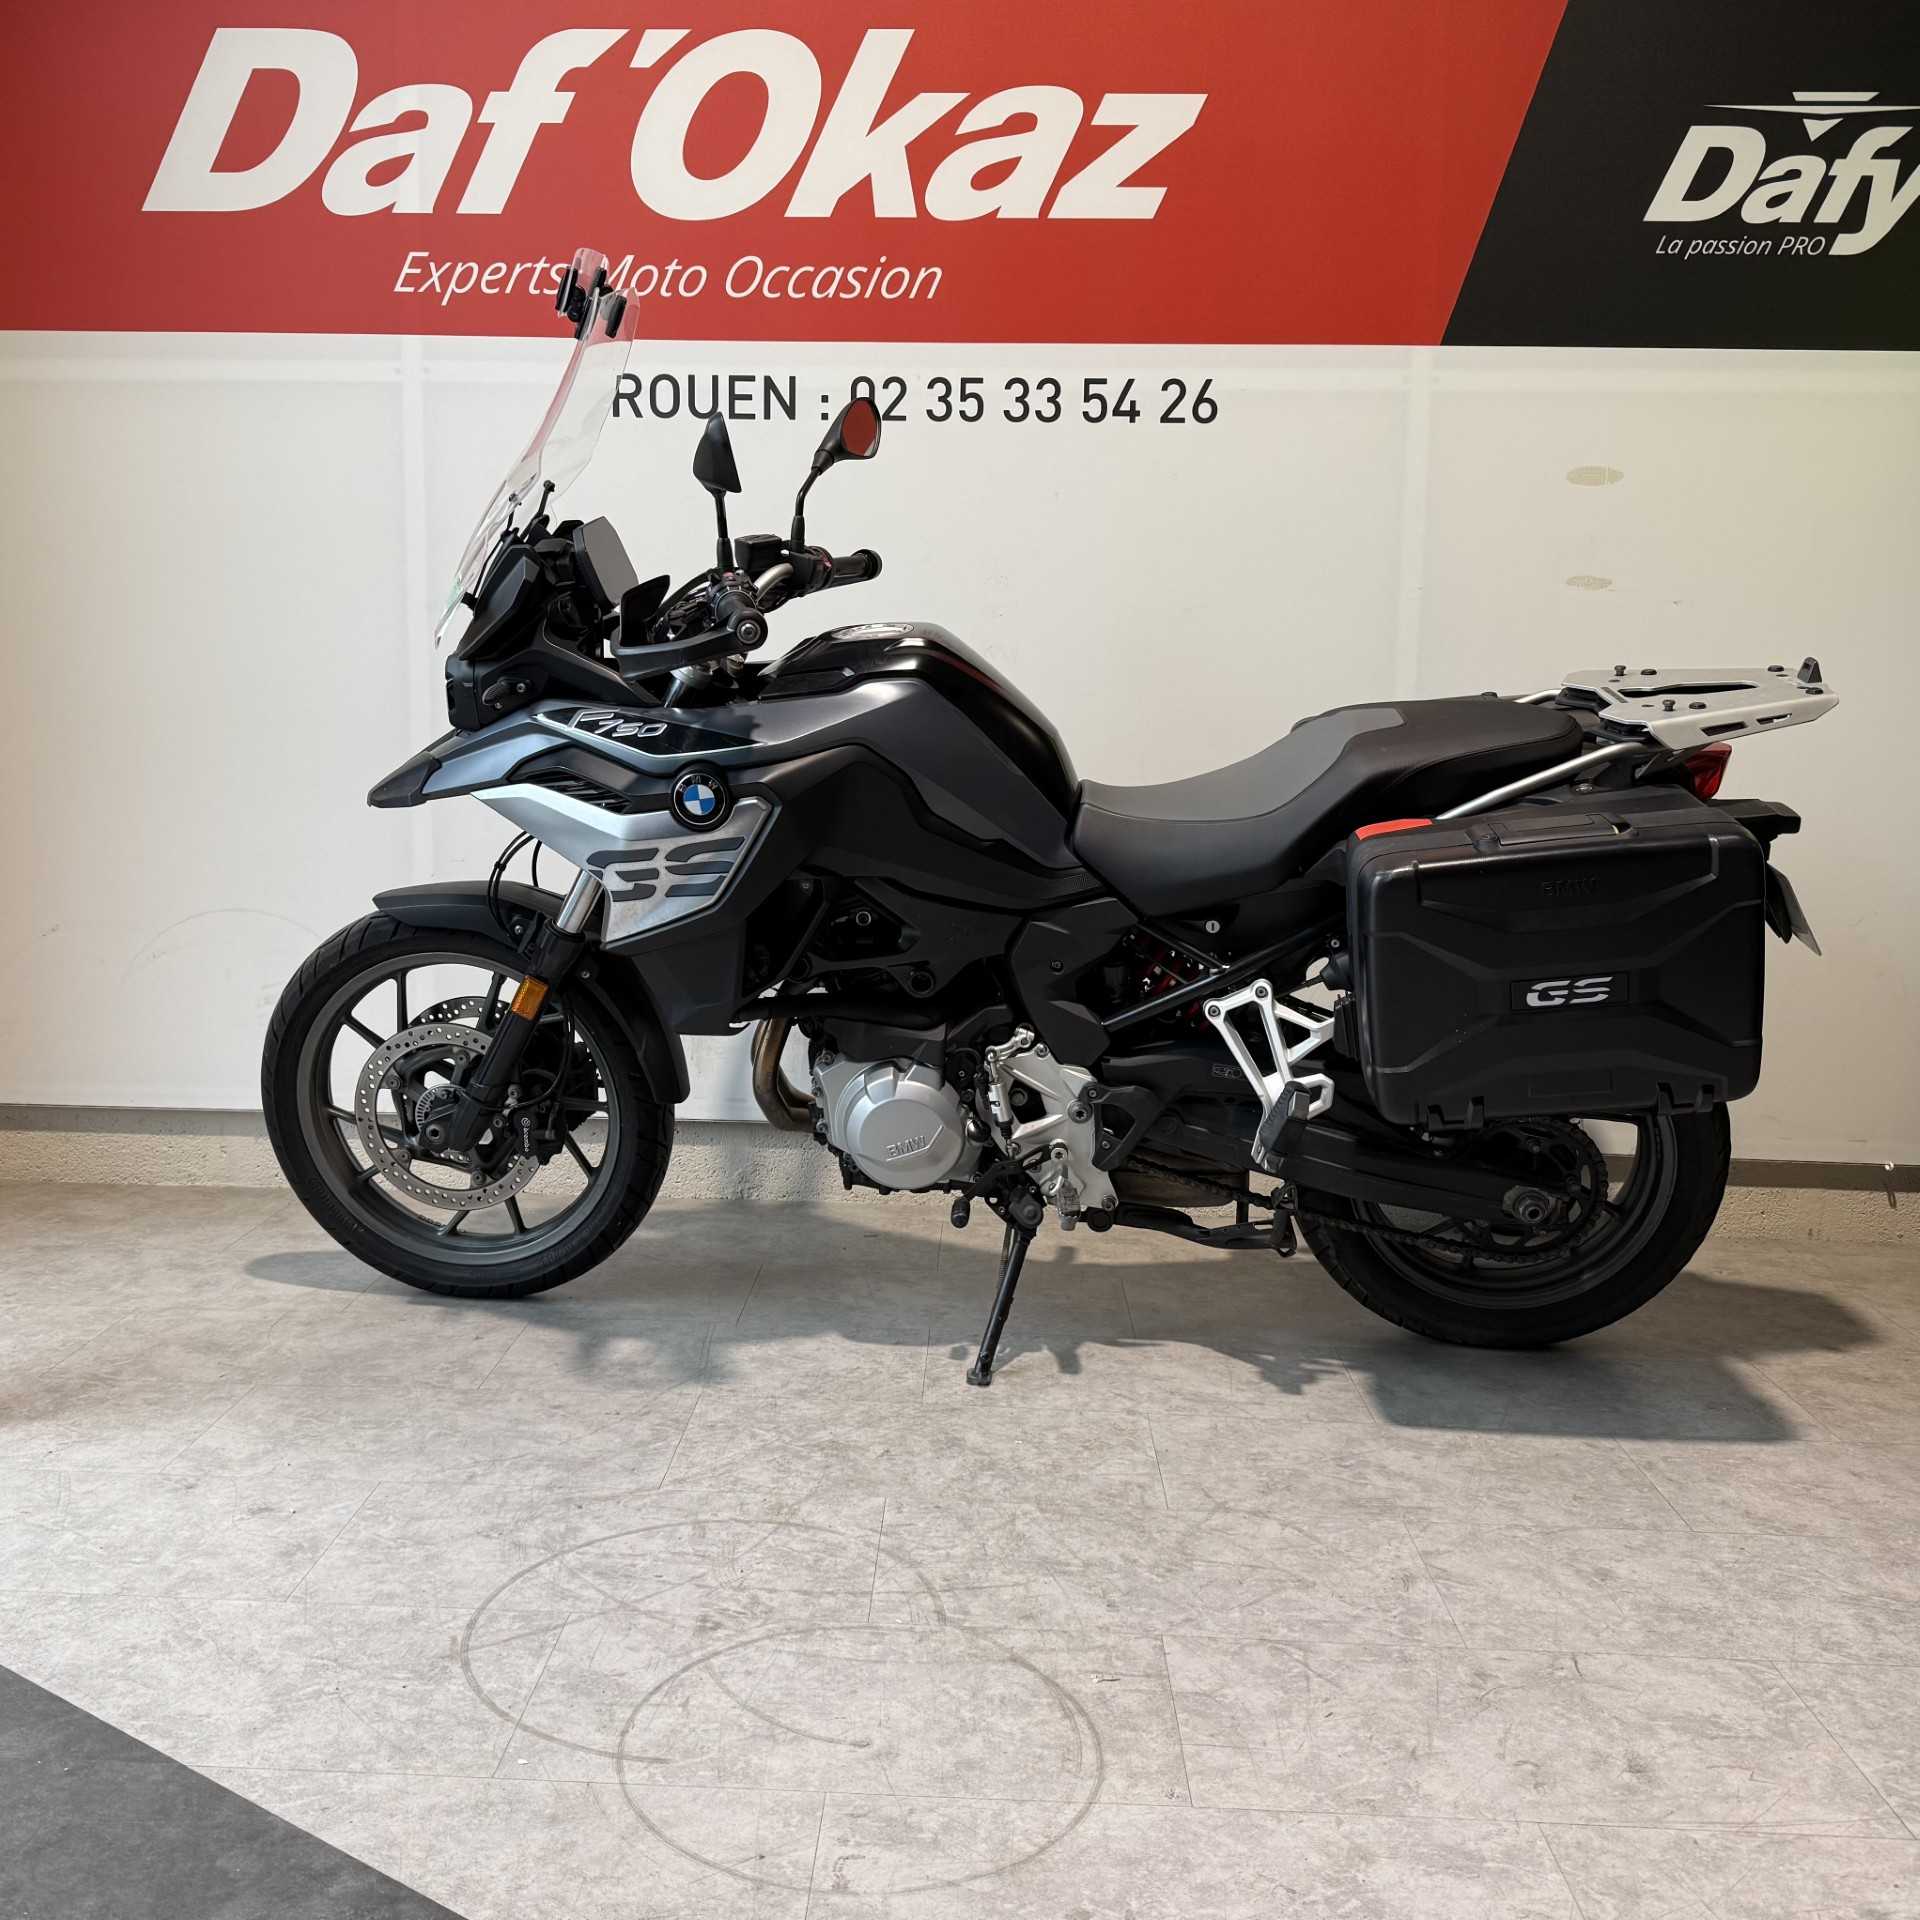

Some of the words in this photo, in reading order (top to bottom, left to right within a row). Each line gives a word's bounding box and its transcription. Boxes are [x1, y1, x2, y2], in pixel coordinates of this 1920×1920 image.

[1642, 124, 1920, 256] Dafy
[1655, 234, 1683, 255] La
[1684, 234, 1772, 260] passion
[1777, 235, 1826, 256] PRO
[393, 251, 569, 305] Experts
[598, 252, 708, 298] Moto
[725, 255, 943, 299] Occasion
[612, 373, 797, 421] ROUEN
[926, 376, 985, 422] 35
[1003, 377, 1062, 423] 33
[1082, 377, 1141, 424] 54
[1159, 378, 1218, 424] 26
[1525, 976, 1613, 1008] GS
[886, 1135, 926, 1157] BMW
